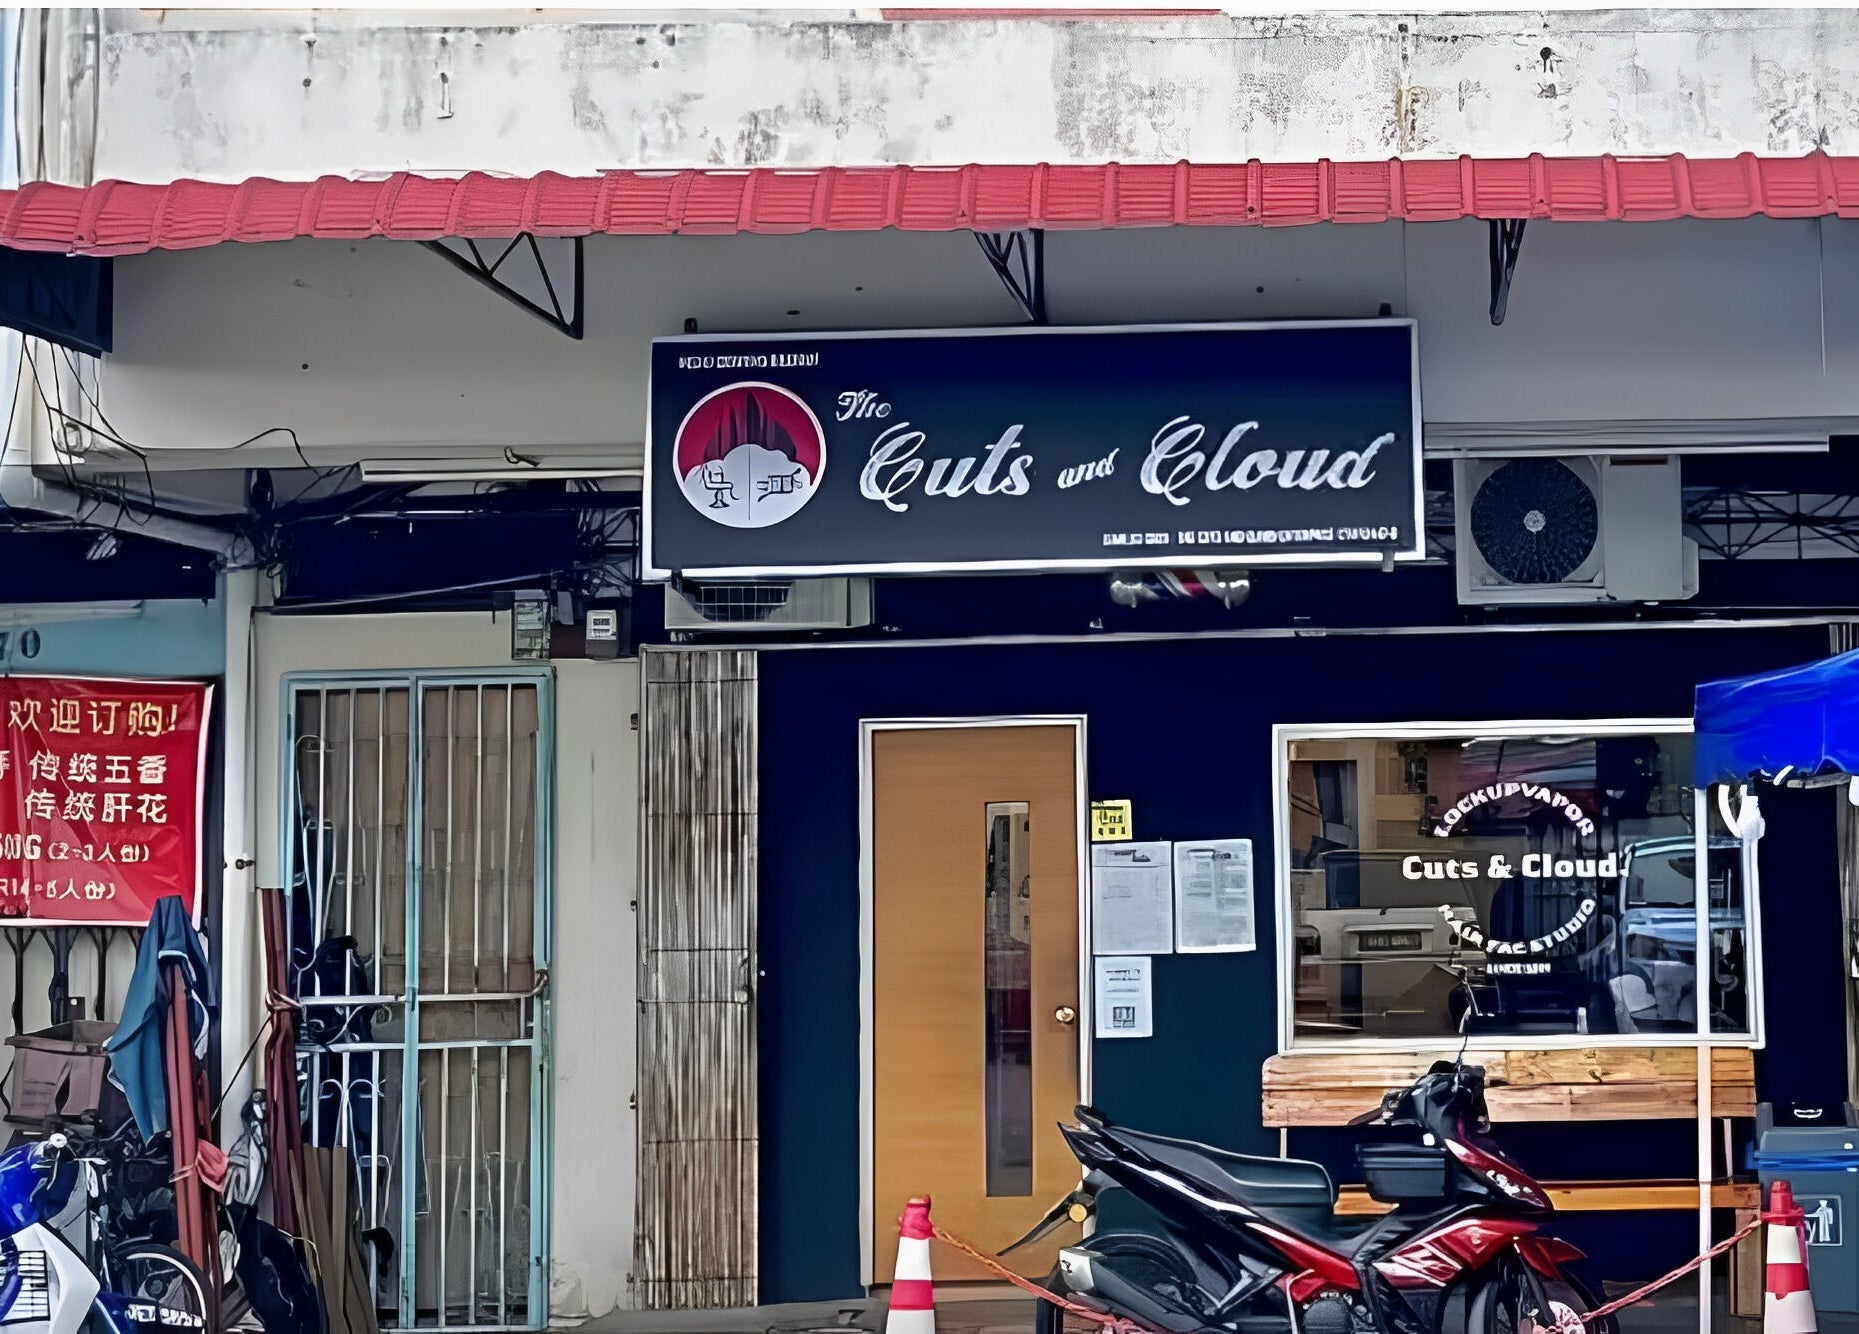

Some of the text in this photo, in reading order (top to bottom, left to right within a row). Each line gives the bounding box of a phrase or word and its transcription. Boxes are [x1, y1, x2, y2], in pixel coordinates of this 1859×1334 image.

[860, 415, 1396, 513] Cuts and Cloud
[1402, 855, 1479, 880] Cuts
[1487, 854, 1514, 878] &
